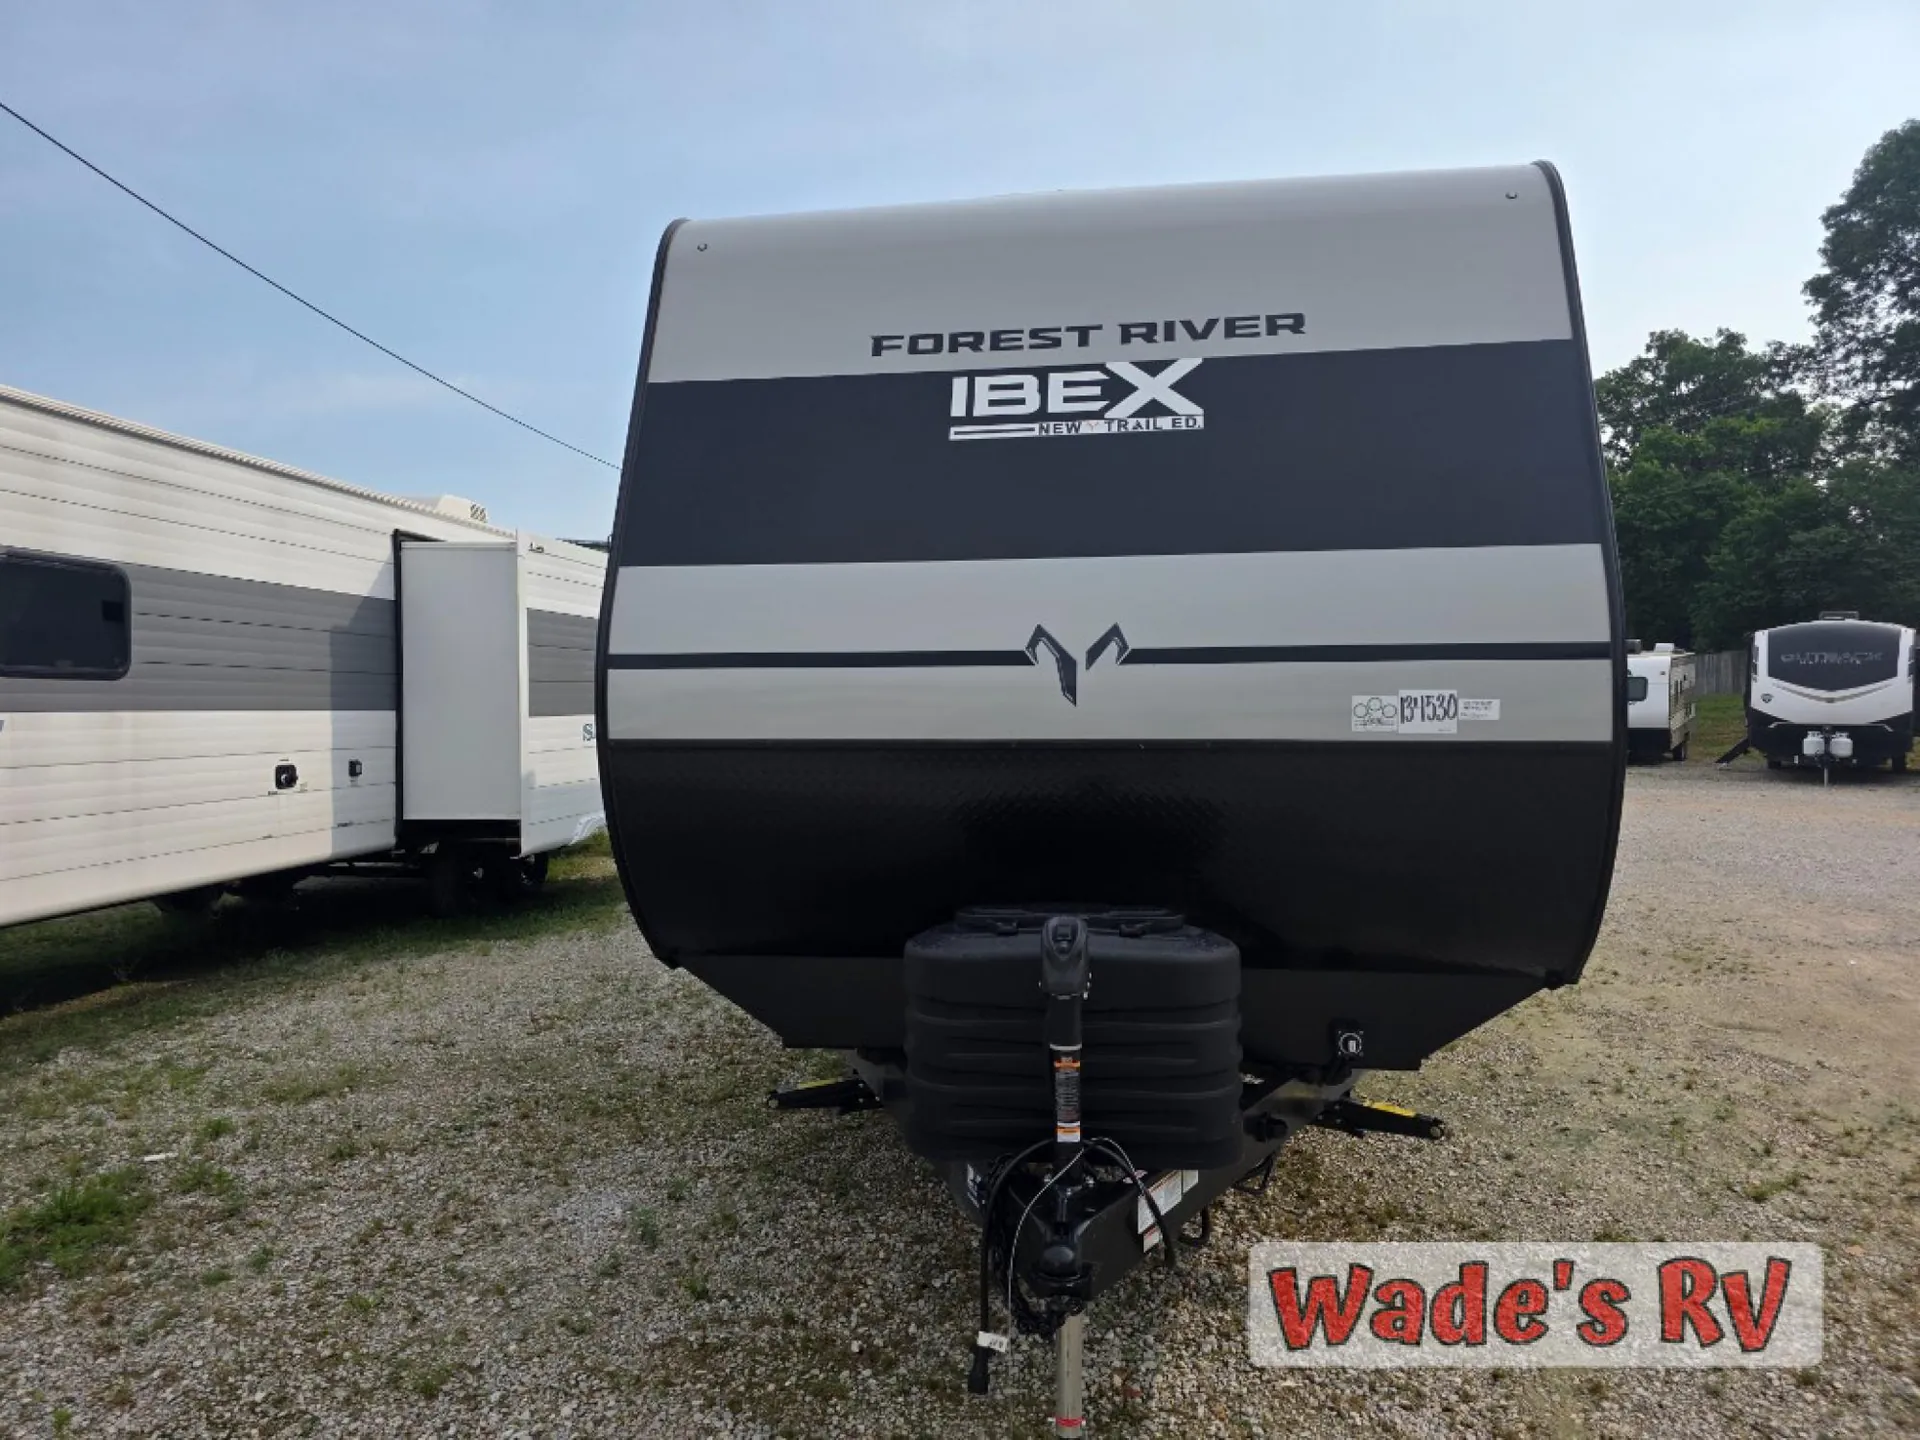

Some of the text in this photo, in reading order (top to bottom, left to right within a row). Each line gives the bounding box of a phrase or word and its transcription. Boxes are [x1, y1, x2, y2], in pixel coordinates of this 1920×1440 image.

[871, 312, 1306, 357] FOREST RIVER
[950, 357, 1205, 419] IBEX
[1039, 416, 1202, 435] NEW TRAIL ED.
